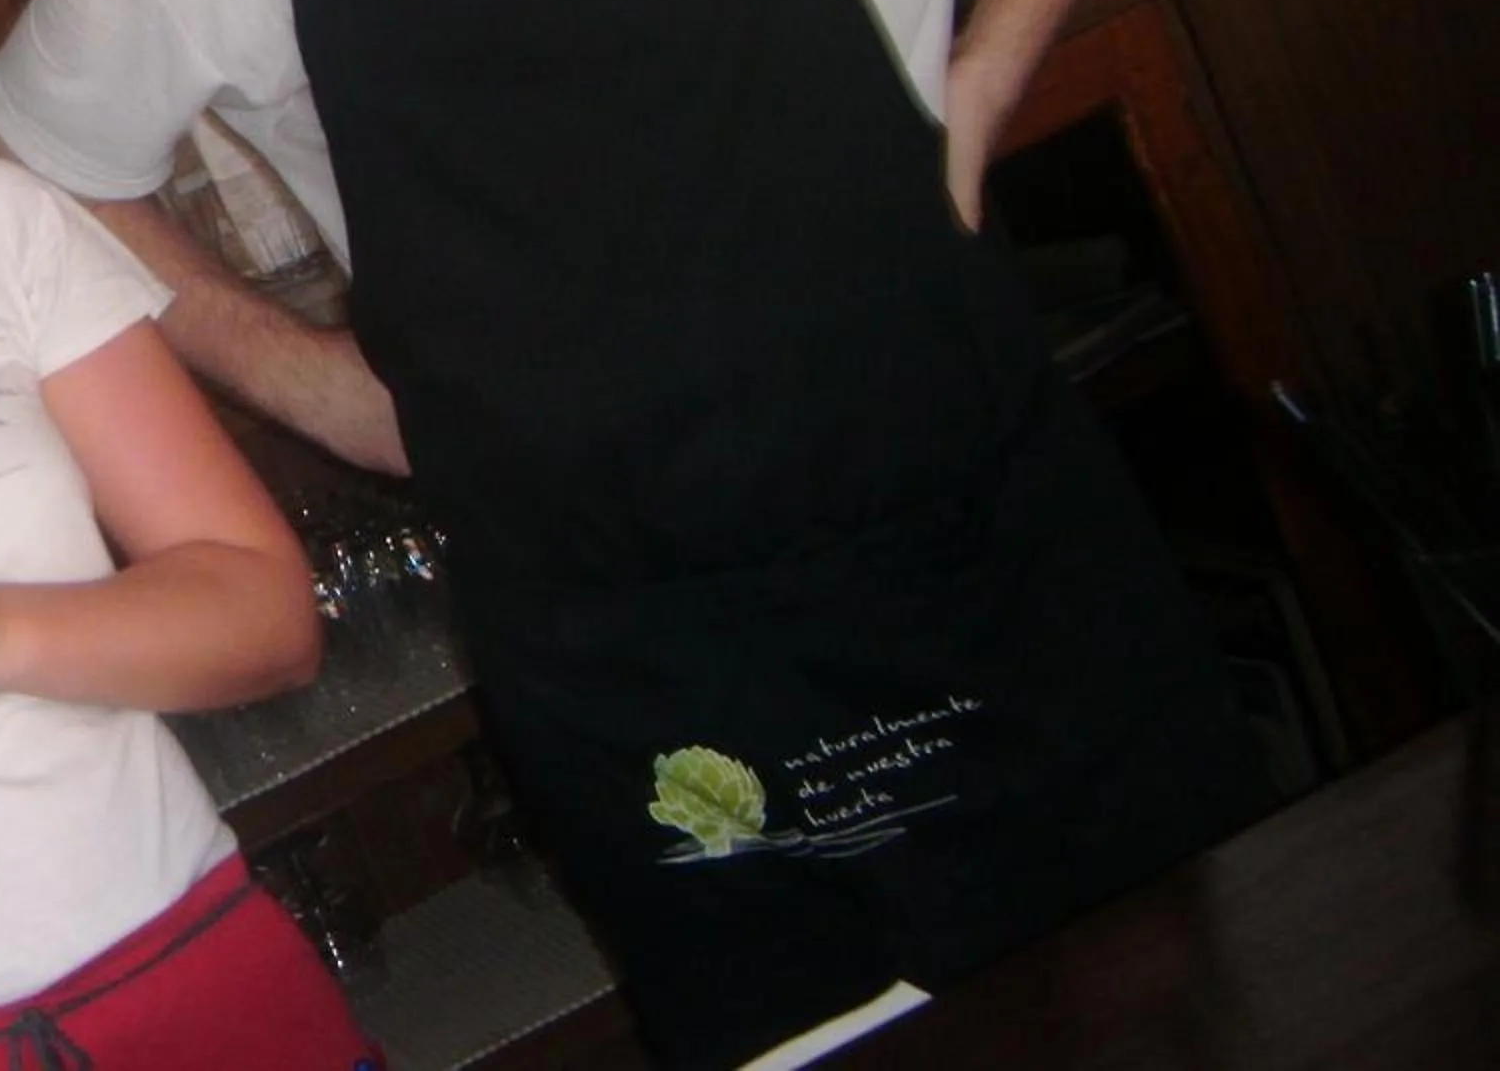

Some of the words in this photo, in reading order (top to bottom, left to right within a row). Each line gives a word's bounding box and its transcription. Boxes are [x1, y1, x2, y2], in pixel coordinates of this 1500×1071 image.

[784, 694, 983, 771] naturalmente
[798, 779, 836, 799] de
[846, 737, 955, 781] nuestra
[803, 786, 895, 828] huerta
